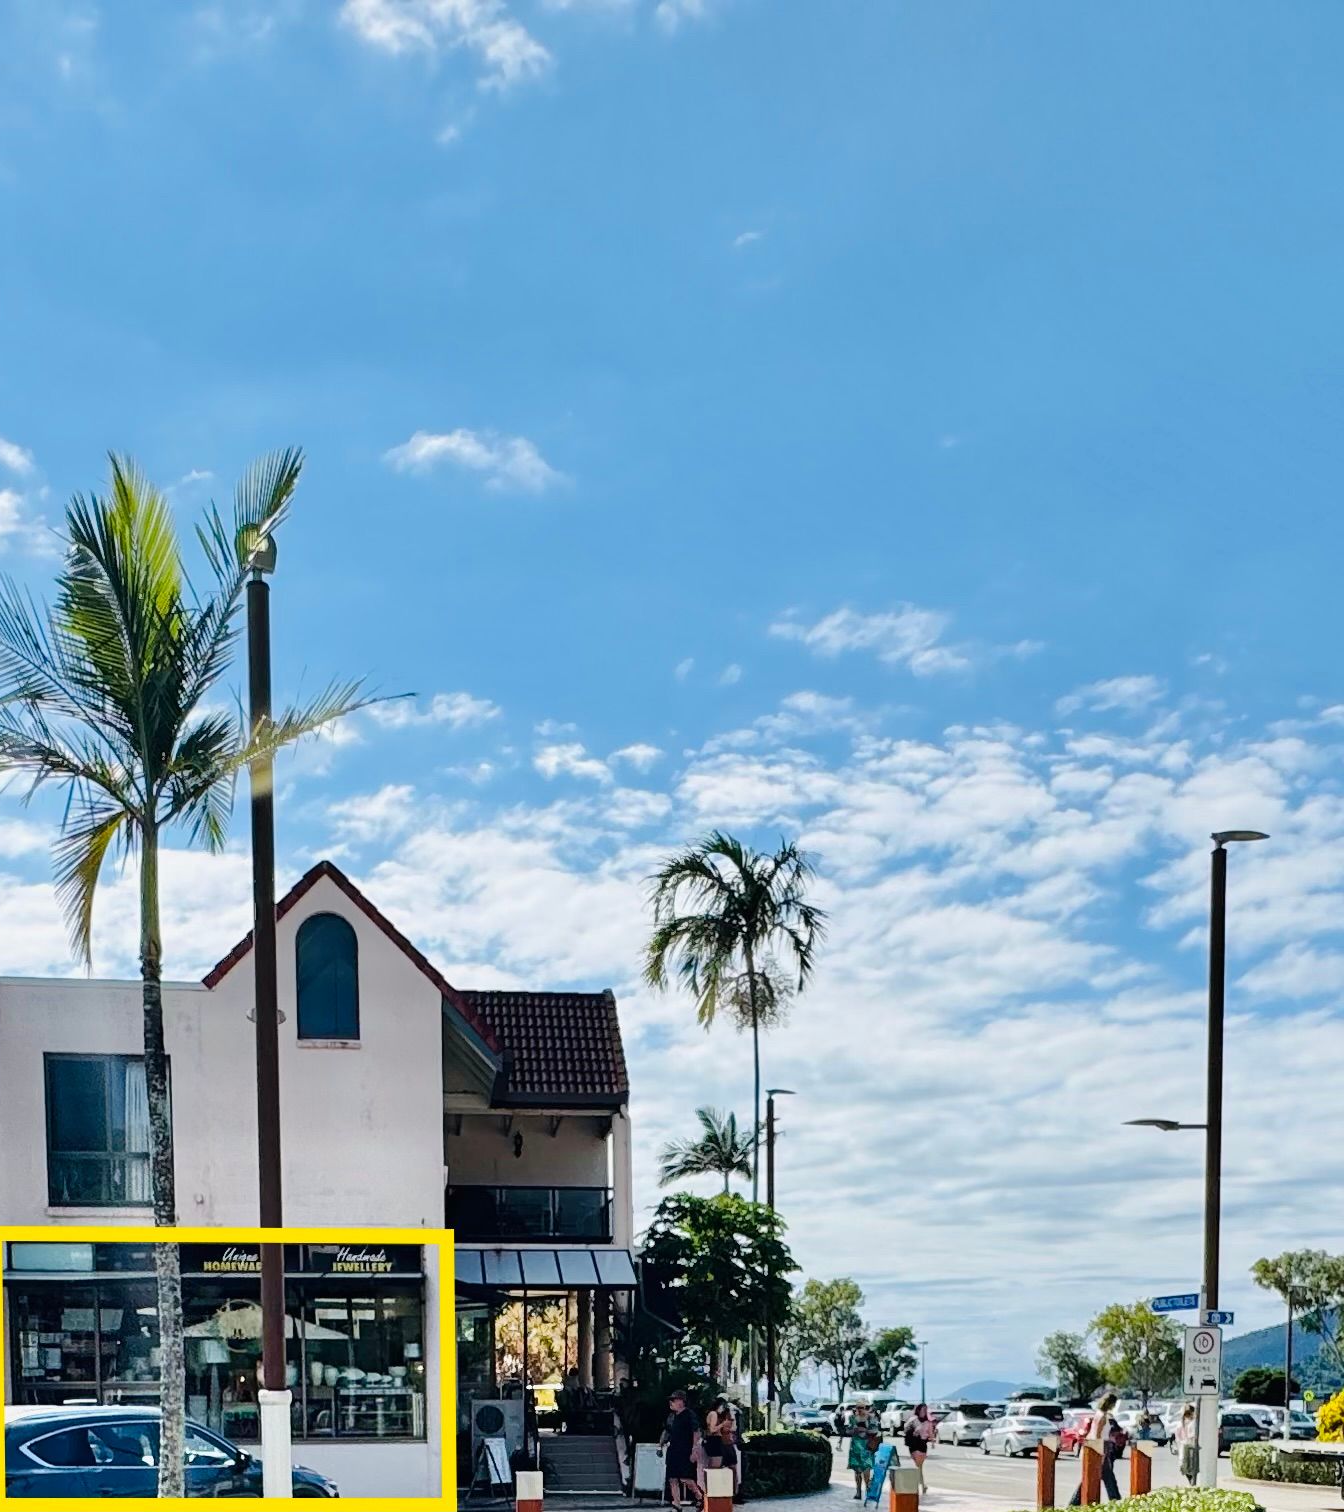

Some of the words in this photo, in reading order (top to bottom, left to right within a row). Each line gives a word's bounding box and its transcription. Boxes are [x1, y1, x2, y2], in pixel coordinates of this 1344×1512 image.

[222, 1247, 260, 1264] Unique
[336, 1246, 387, 1262] Handmade
[332, 1262, 393, 1272] JEWELLERY
